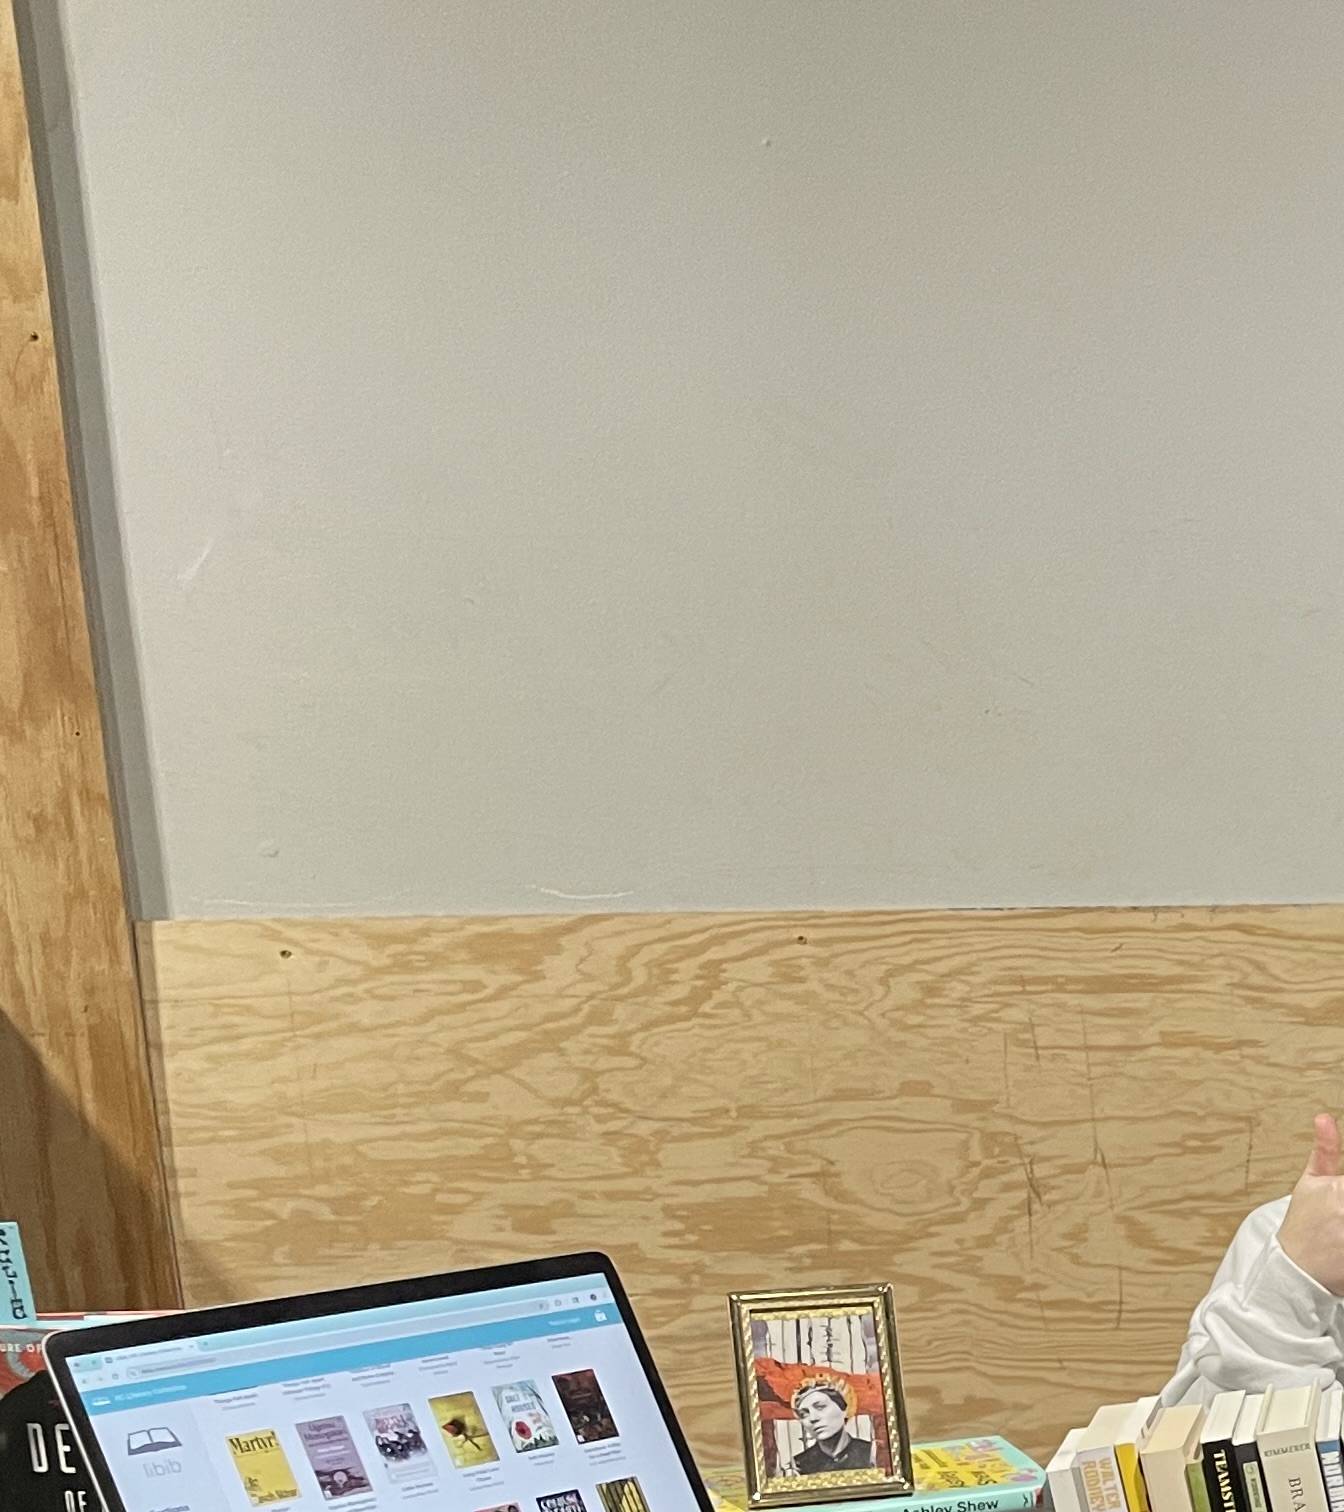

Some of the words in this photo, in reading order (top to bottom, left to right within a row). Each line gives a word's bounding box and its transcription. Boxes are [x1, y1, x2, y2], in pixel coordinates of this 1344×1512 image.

[142, 1460, 182, 1479] libib
[1081, 1460, 1107, 1512] RODNEY
[1098, 1457, 1122, 1510] WALTER
